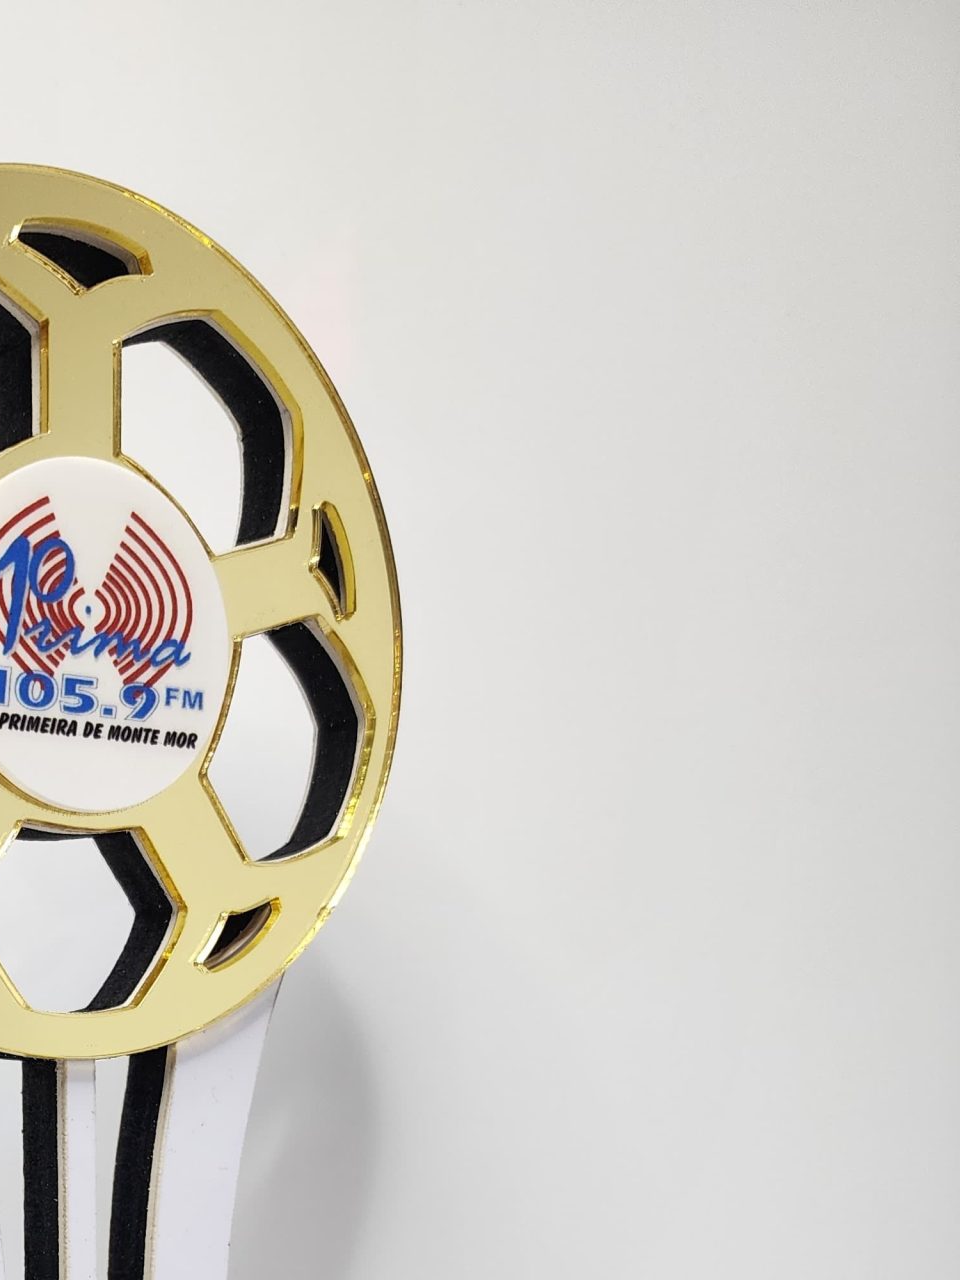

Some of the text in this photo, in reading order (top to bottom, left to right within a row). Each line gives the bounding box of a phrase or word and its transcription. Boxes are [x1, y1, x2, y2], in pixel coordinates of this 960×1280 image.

[164, 687, 204, 711] FM
[81, 721, 104, 739] DE
[107, 727, 161, 746] MONTE
[163, 731, 198, 749] MOR
